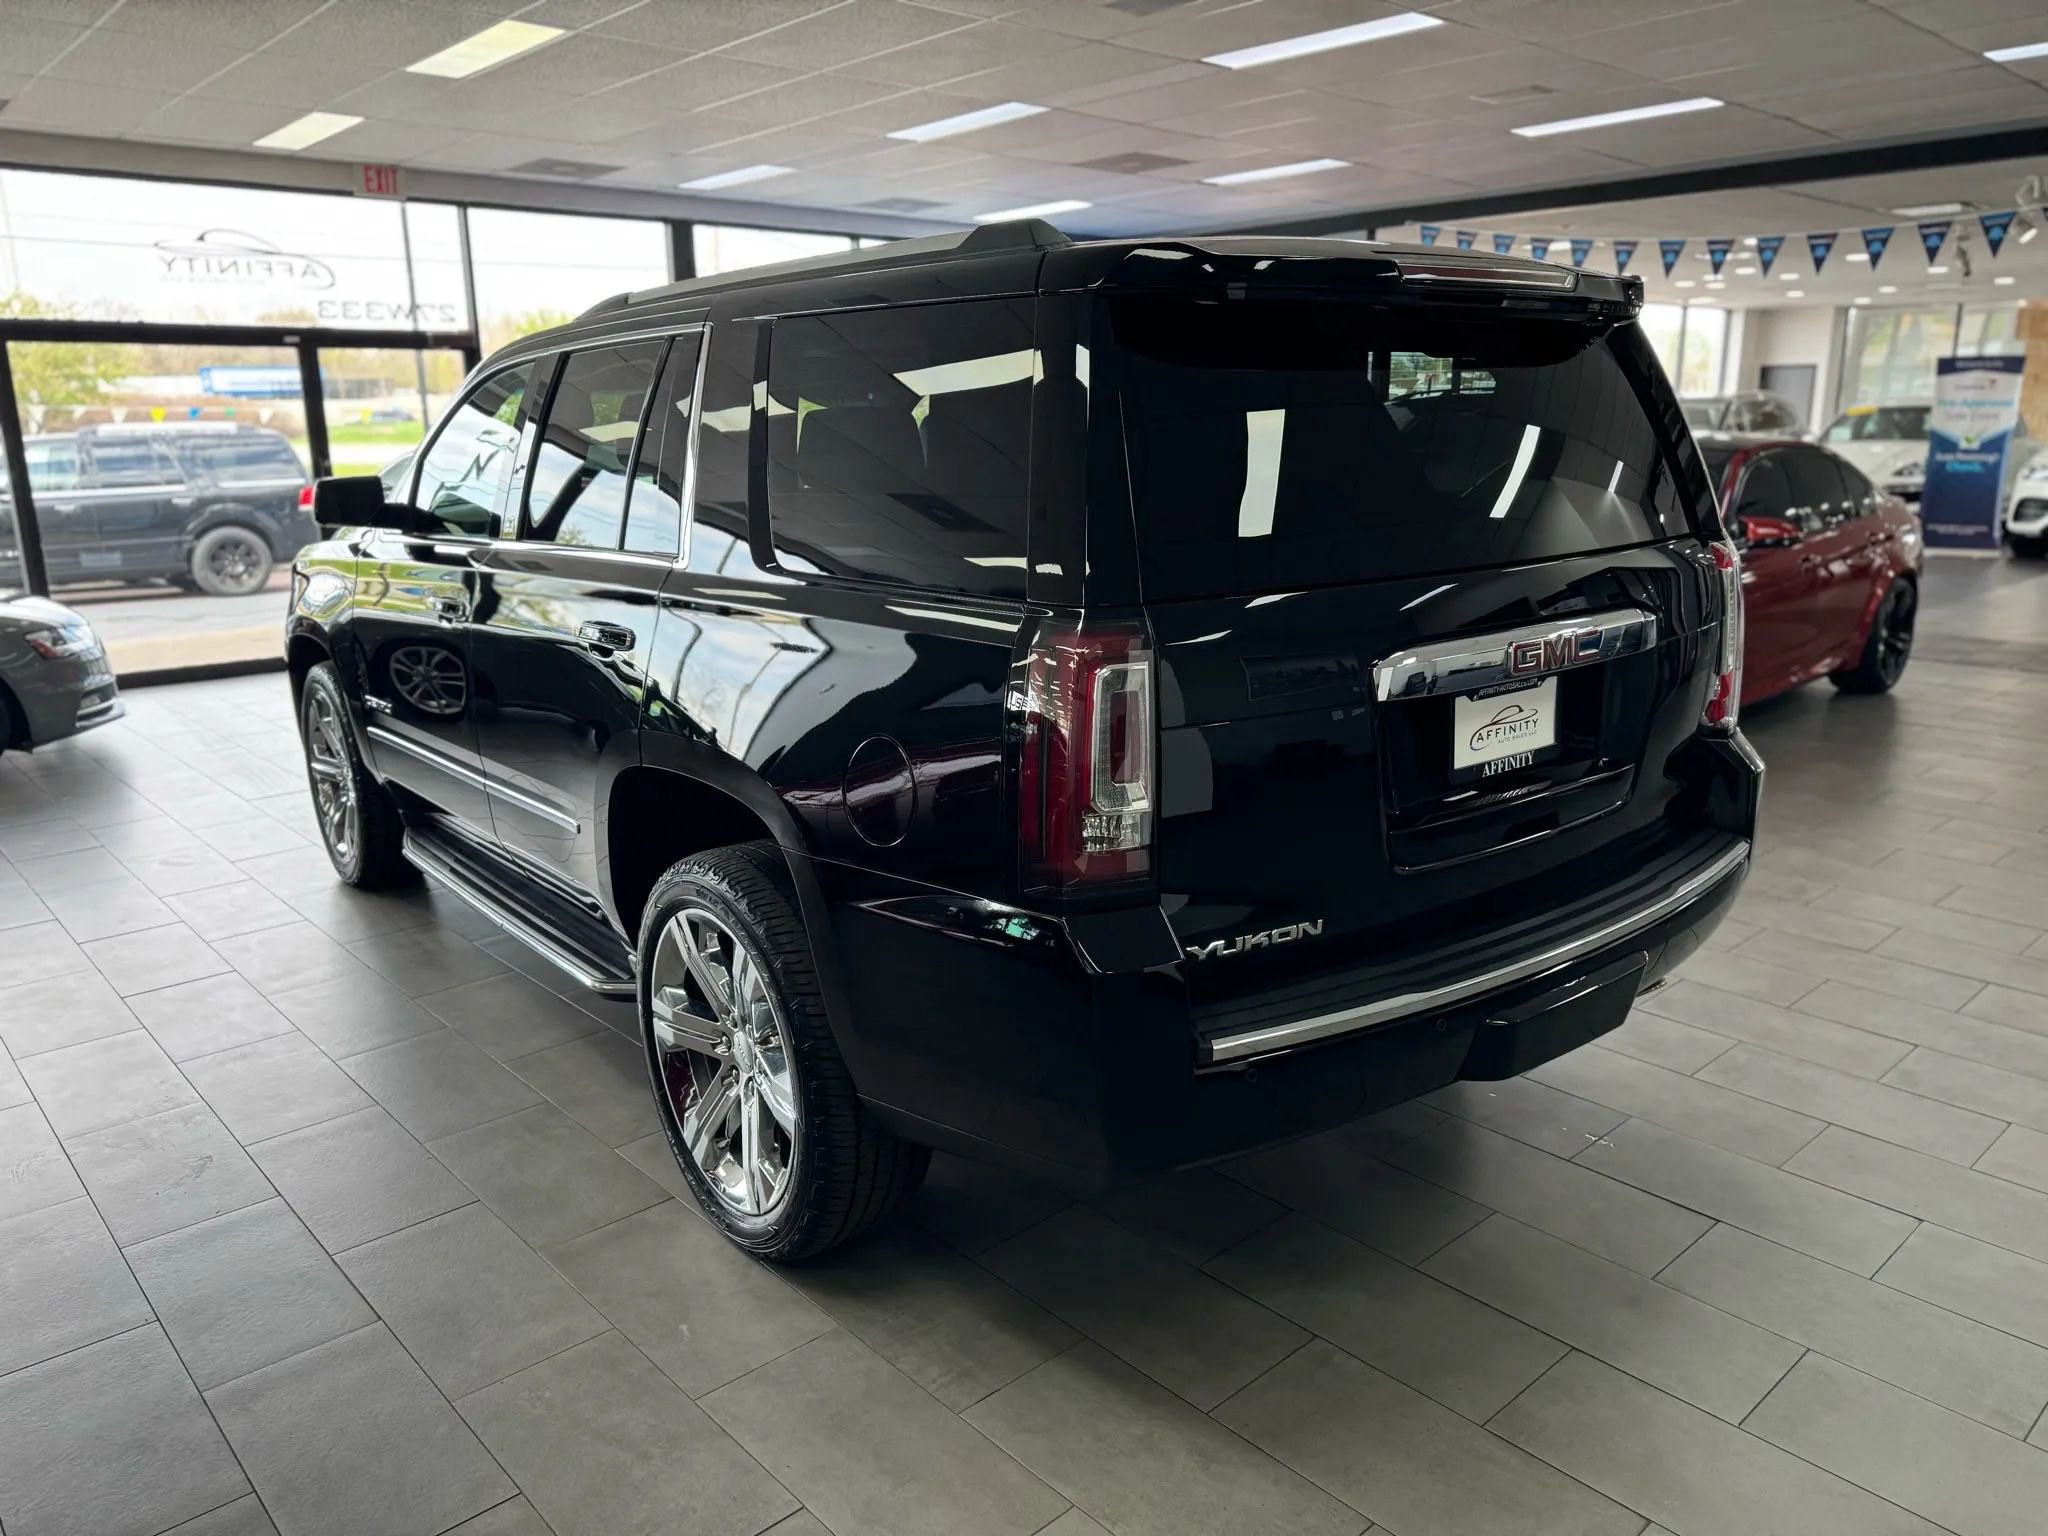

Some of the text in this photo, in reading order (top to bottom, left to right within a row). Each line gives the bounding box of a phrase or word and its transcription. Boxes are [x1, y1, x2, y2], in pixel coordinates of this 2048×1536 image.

[362, 163, 399, 194] EXIT
[1511, 627, 1602, 675] GMC
[1476, 718, 1539, 743] AFFINITY
[1482, 751, 1535, 778] AFFINITY
[1185, 919, 1324, 961] YUKON
